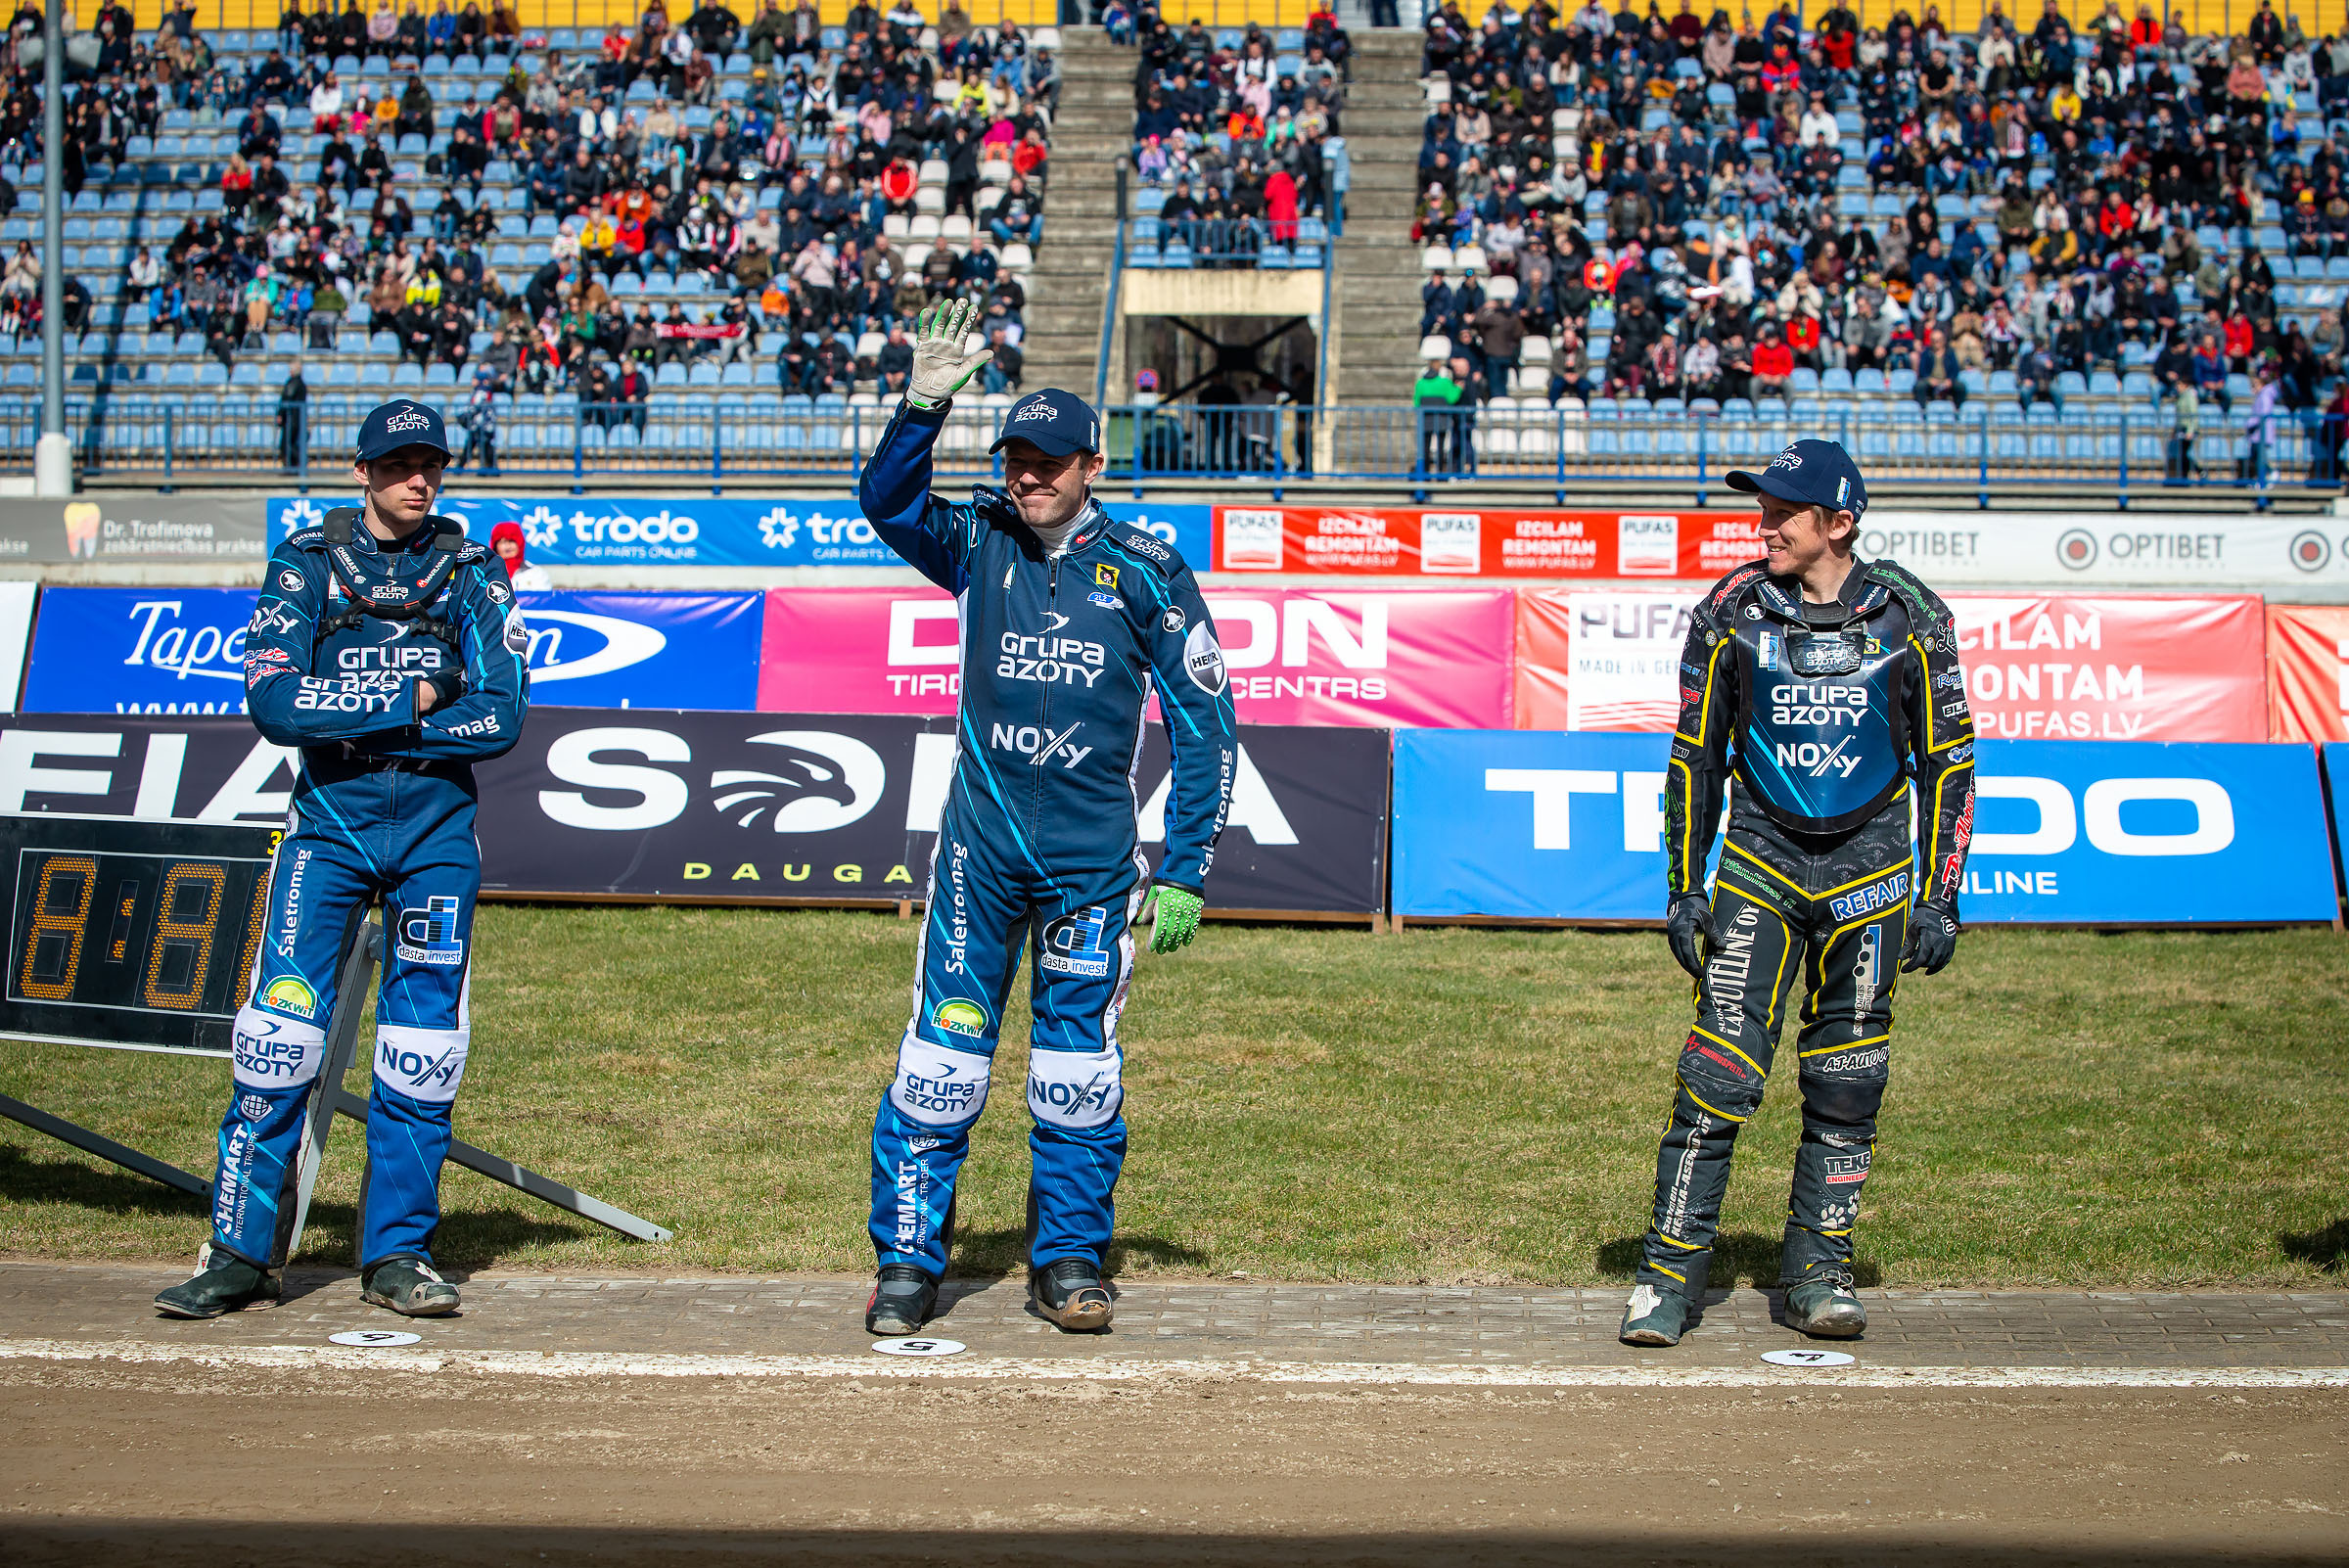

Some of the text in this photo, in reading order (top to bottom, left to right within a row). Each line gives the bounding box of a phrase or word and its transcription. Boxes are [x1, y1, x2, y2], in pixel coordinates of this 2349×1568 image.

[569, 510, 699, 543] trodo
[805, 512, 876, 544] tro
[1713, 523, 1761, 539] IZCILA
[576, 546, 602, 559] CAR
[1501, 539, 1596, 556] REMONTAM
[1863, 530, 1979, 558] OPTIBET
[2109, 532, 2226, 559] OPTIBET
[1581, 604, 1691, 638] PUFA
[1230, 676, 1387, 700] CENTRS
[1961, 664, 2143, 702] ONTAM
[1975, 711, 2142, 738] PUFAS.LV
[683, 861, 913, 884] DAUGA
[277, 849, 313, 958] Saletromag
[945, 841, 968, 975] Saletromag
[1830, 872, 1909, 921] REFAIR
[398, 945, 461, 963] dasta invest
[1041, 953, 1106, 975] dasta invest
[244, 1131, 259, 1173] TRADER
[216, 1125, 249, 1235] CHEMART
[919, 1158, 930, 1195] TRADER
[897, 1161, 918, 1255] CHEMART
